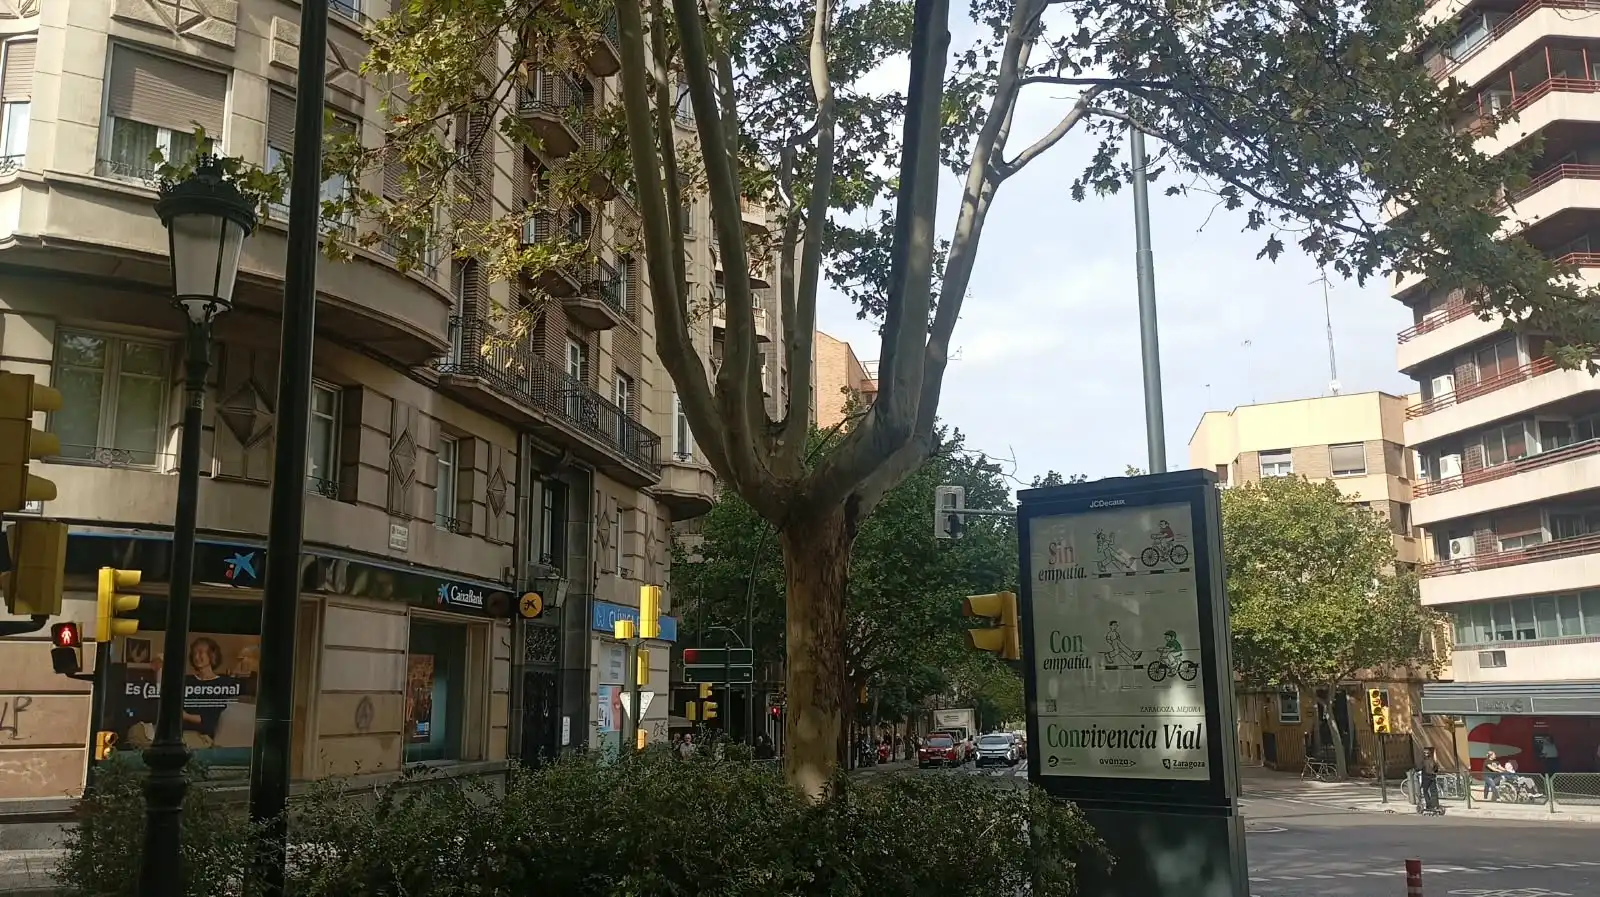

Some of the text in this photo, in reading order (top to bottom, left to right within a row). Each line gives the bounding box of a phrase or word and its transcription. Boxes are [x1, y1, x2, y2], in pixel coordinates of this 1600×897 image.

[1090, 499, 1126, 508] JCDecaux
[1049, 541, 1075, 564] Sin
[1038, 564, 1088, 584] empatía.
[451, 585, 483, 605] CaixaBank
[1050, 631, 1083, 653] Con
[1043, 654, 1092, 674] empatía.
[125, 683, 141, 695] Es
[184, 684, 240, 697] personal
[1047, 723, 1202, 749] Convivencia Vial
[1172, 759, 1206, 769] Zaragoza
